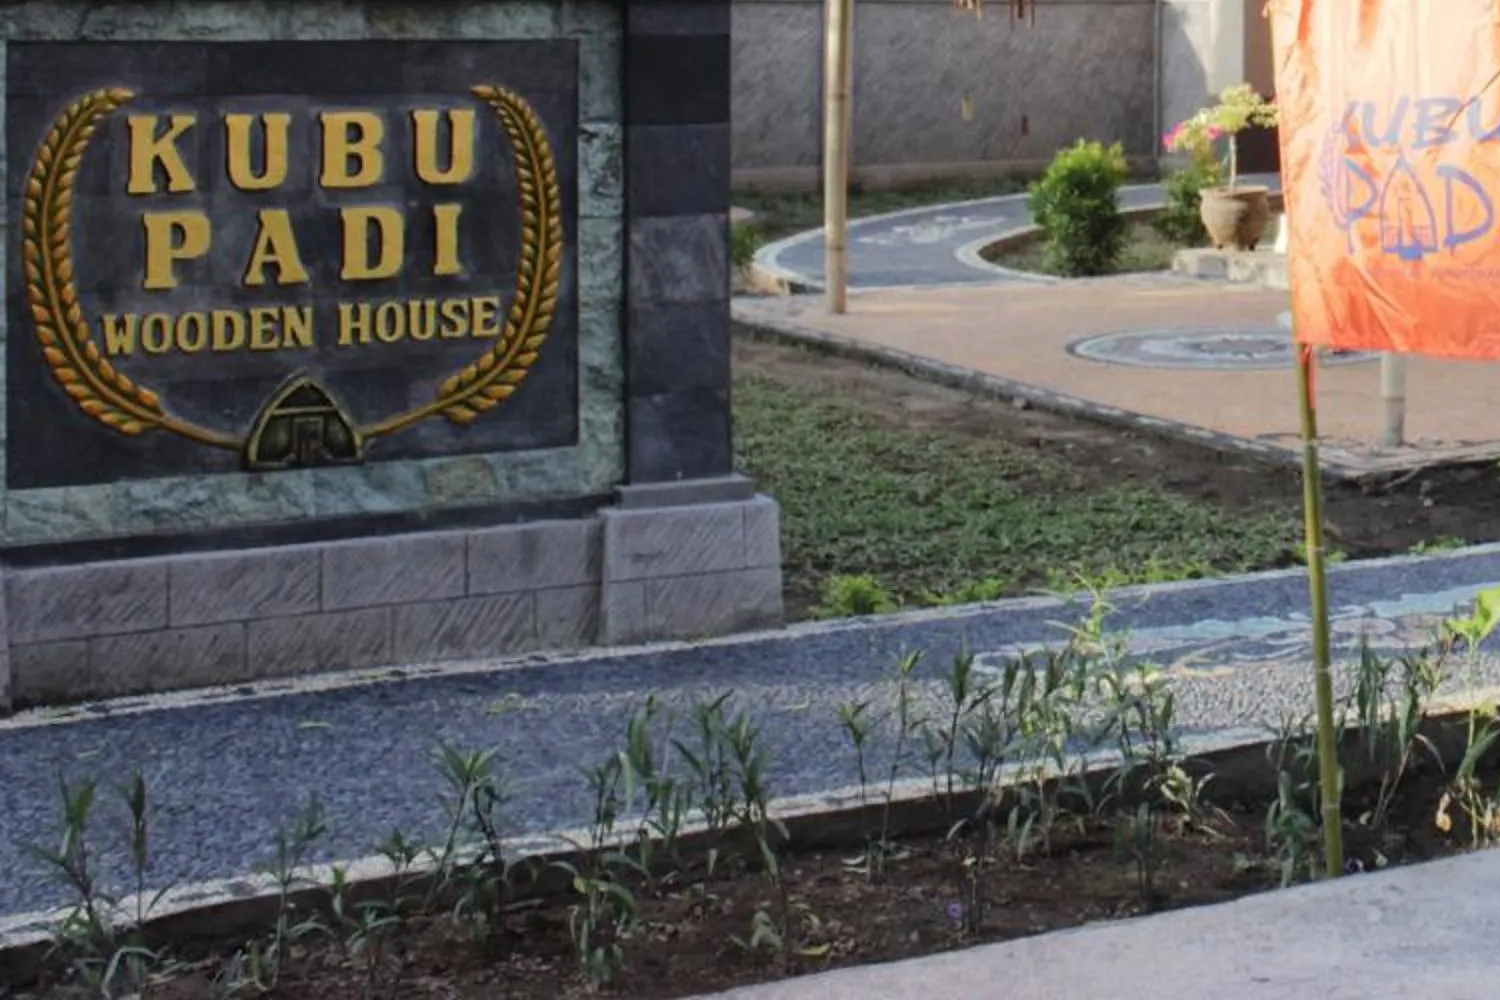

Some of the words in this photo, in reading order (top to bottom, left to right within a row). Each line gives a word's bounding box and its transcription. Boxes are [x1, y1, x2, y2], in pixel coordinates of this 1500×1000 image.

[127, 108, 477, 194] KUBU
[142, 203, 463, 290] PADI
[102, 304, 314, 356] WOODEN
[337, 296, 500, 346] HOUSE
